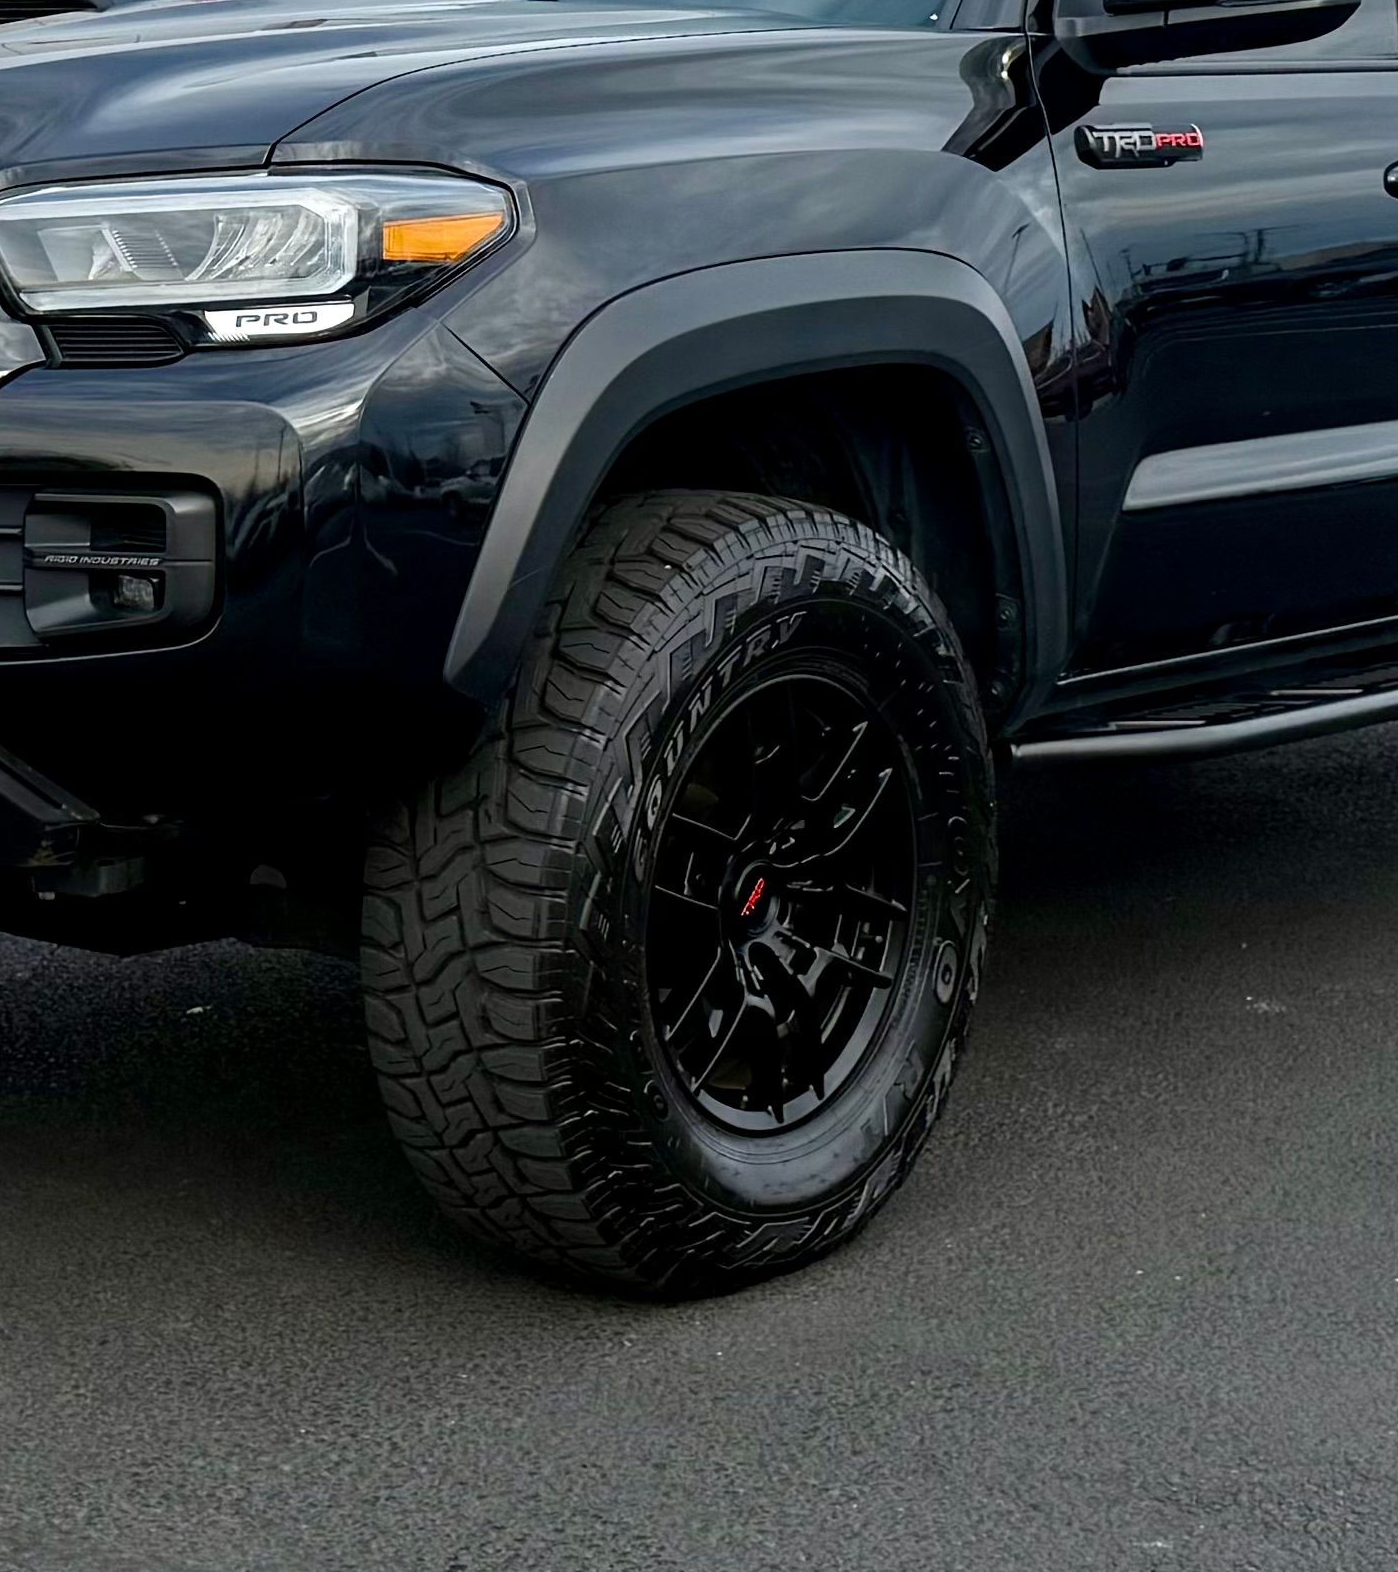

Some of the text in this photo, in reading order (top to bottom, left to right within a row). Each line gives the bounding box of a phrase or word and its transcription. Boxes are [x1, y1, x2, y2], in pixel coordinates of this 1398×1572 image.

[1092, 130, 1202, 159] TRD PRO
[236, 311, 318, 328] PRO
